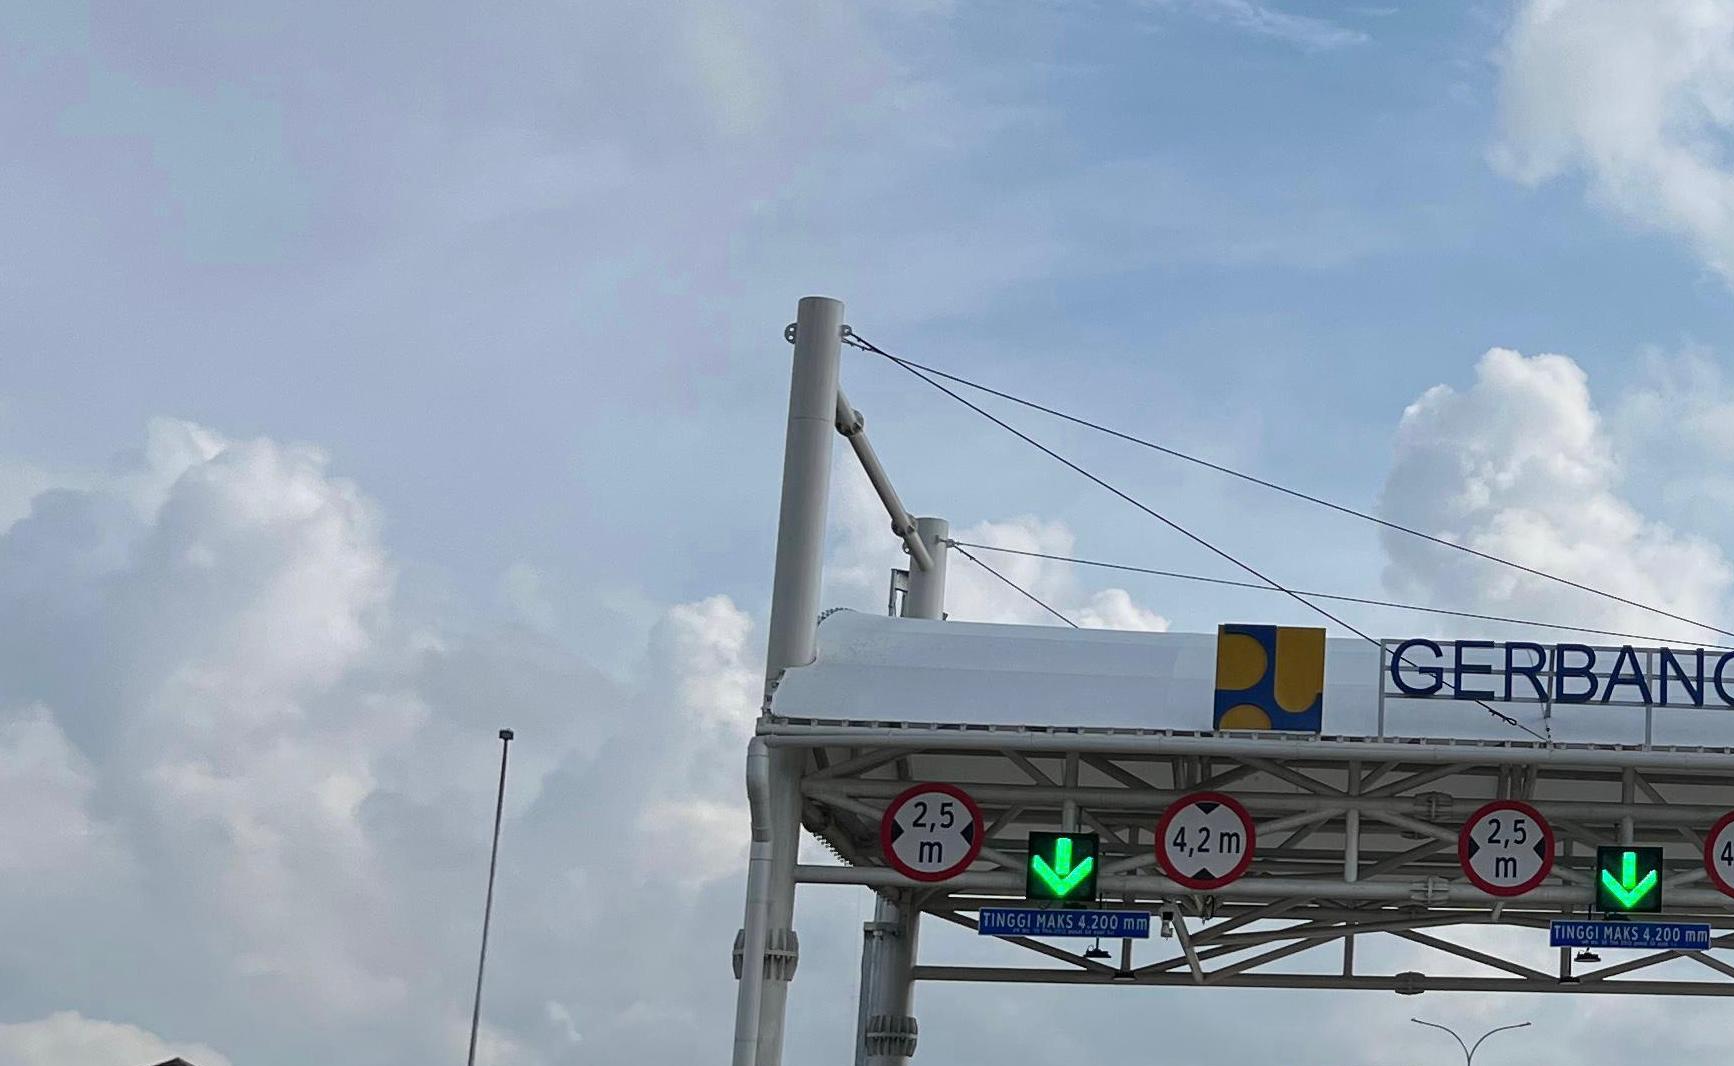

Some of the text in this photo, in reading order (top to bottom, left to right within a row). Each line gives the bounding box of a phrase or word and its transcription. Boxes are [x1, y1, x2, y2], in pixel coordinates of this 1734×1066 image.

[911, 801, 956, 831] 2,5
[1172, 825, 1242, 857] 4,2 m
[1486, 818, 1528, 848] 2,5
[918, 839, 944, 864] m
[1494, 855, 1518, 879] m
[983, 912, 1148, 931] TINGGI MAKS 4.200 mm
[1553, 925, 1599, 940] TINGGI
[1604, 926, 1639, 941] MAKS
[1643, 927, 1681, 942] 4.200
[1685, 930, 1708, 943] mm
